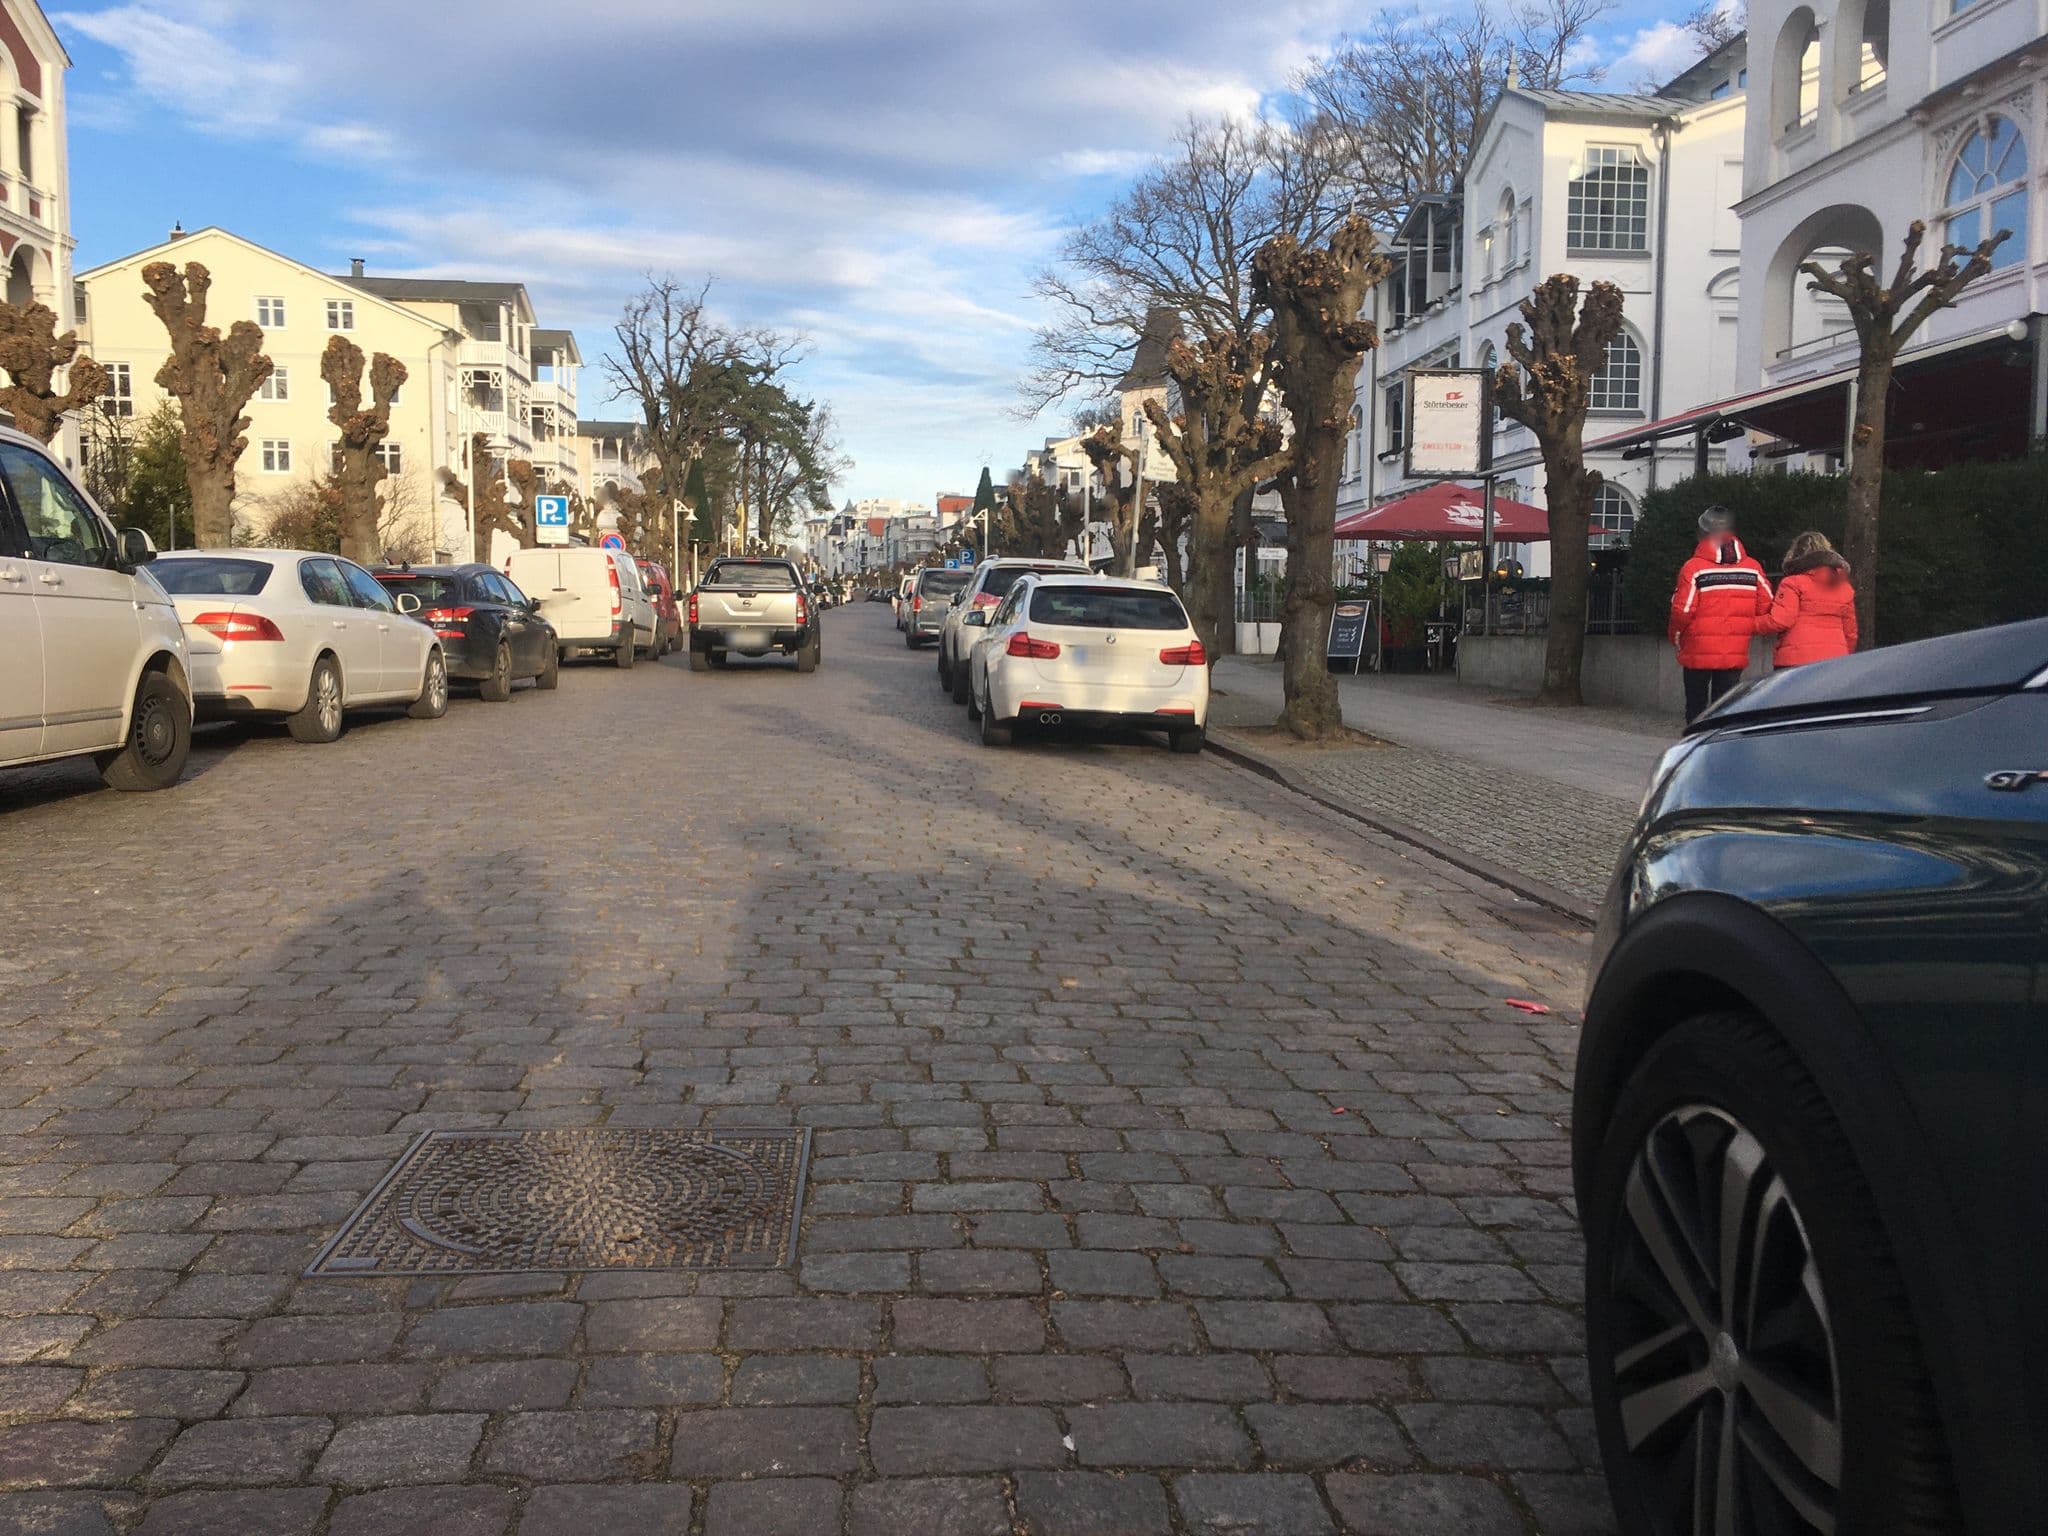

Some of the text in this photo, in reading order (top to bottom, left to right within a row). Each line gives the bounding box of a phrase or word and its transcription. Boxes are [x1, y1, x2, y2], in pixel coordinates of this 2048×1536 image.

[1423, 400, 1469, 409] Störtebeker
[541, 499, 559, 523] P
[961, 551, 971, 563] P
[947, 560, 955, 569] P
